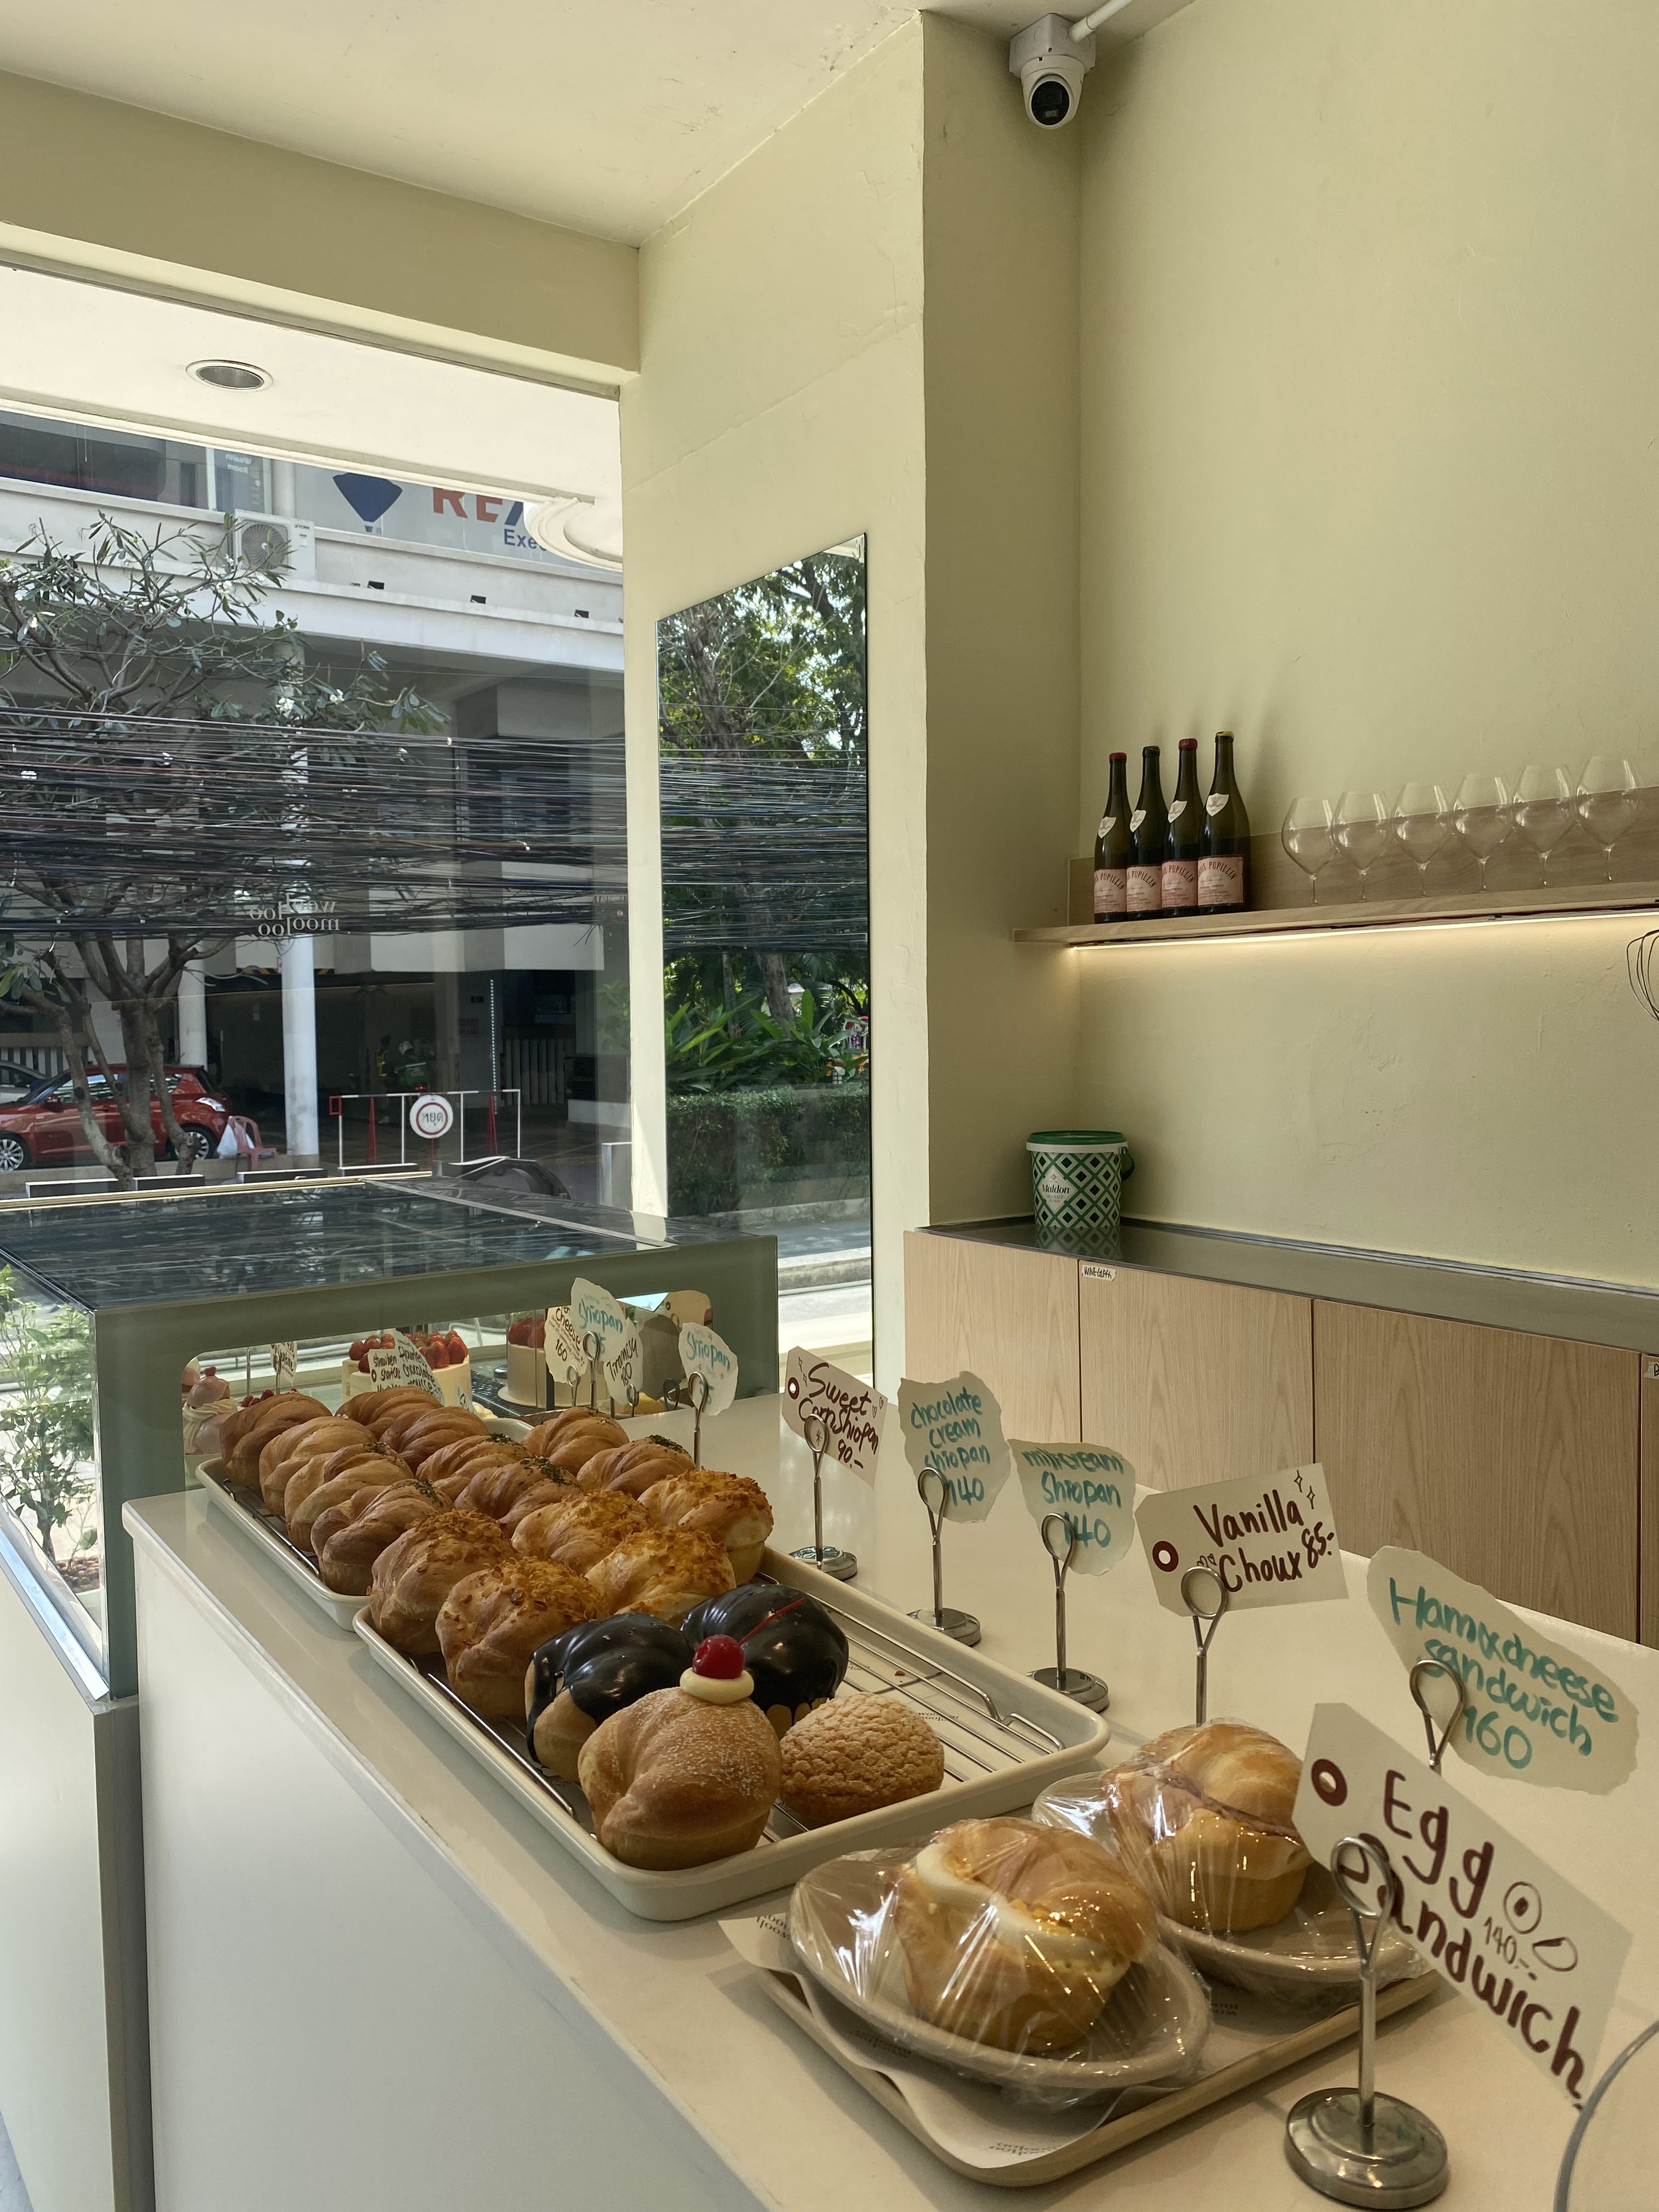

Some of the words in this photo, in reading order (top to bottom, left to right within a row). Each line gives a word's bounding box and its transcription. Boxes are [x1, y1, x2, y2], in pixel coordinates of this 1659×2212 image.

[1132, 870, 1157, 888] PUPILLIN
[1169, 865, 1195, 883] PUPILLIN
[1209, 861, 1237, 880] PUPILLIN
[1042, 1184, 1069, 1194] Maldon
[556, 1339, 568, 1362] 160
[808, 1362, 872, 1416] Sweet
[929, 1417, 981, 1449] cream
[946, 1476, 985, 1507] 140
[1193, 1489, 1305, 1548] Vanilla
[1218, 1547, 1303, 1593] Choux
[1464, 1705, 1533, 1769] 160
[1383, 1769, 1494, 1919] Egg
